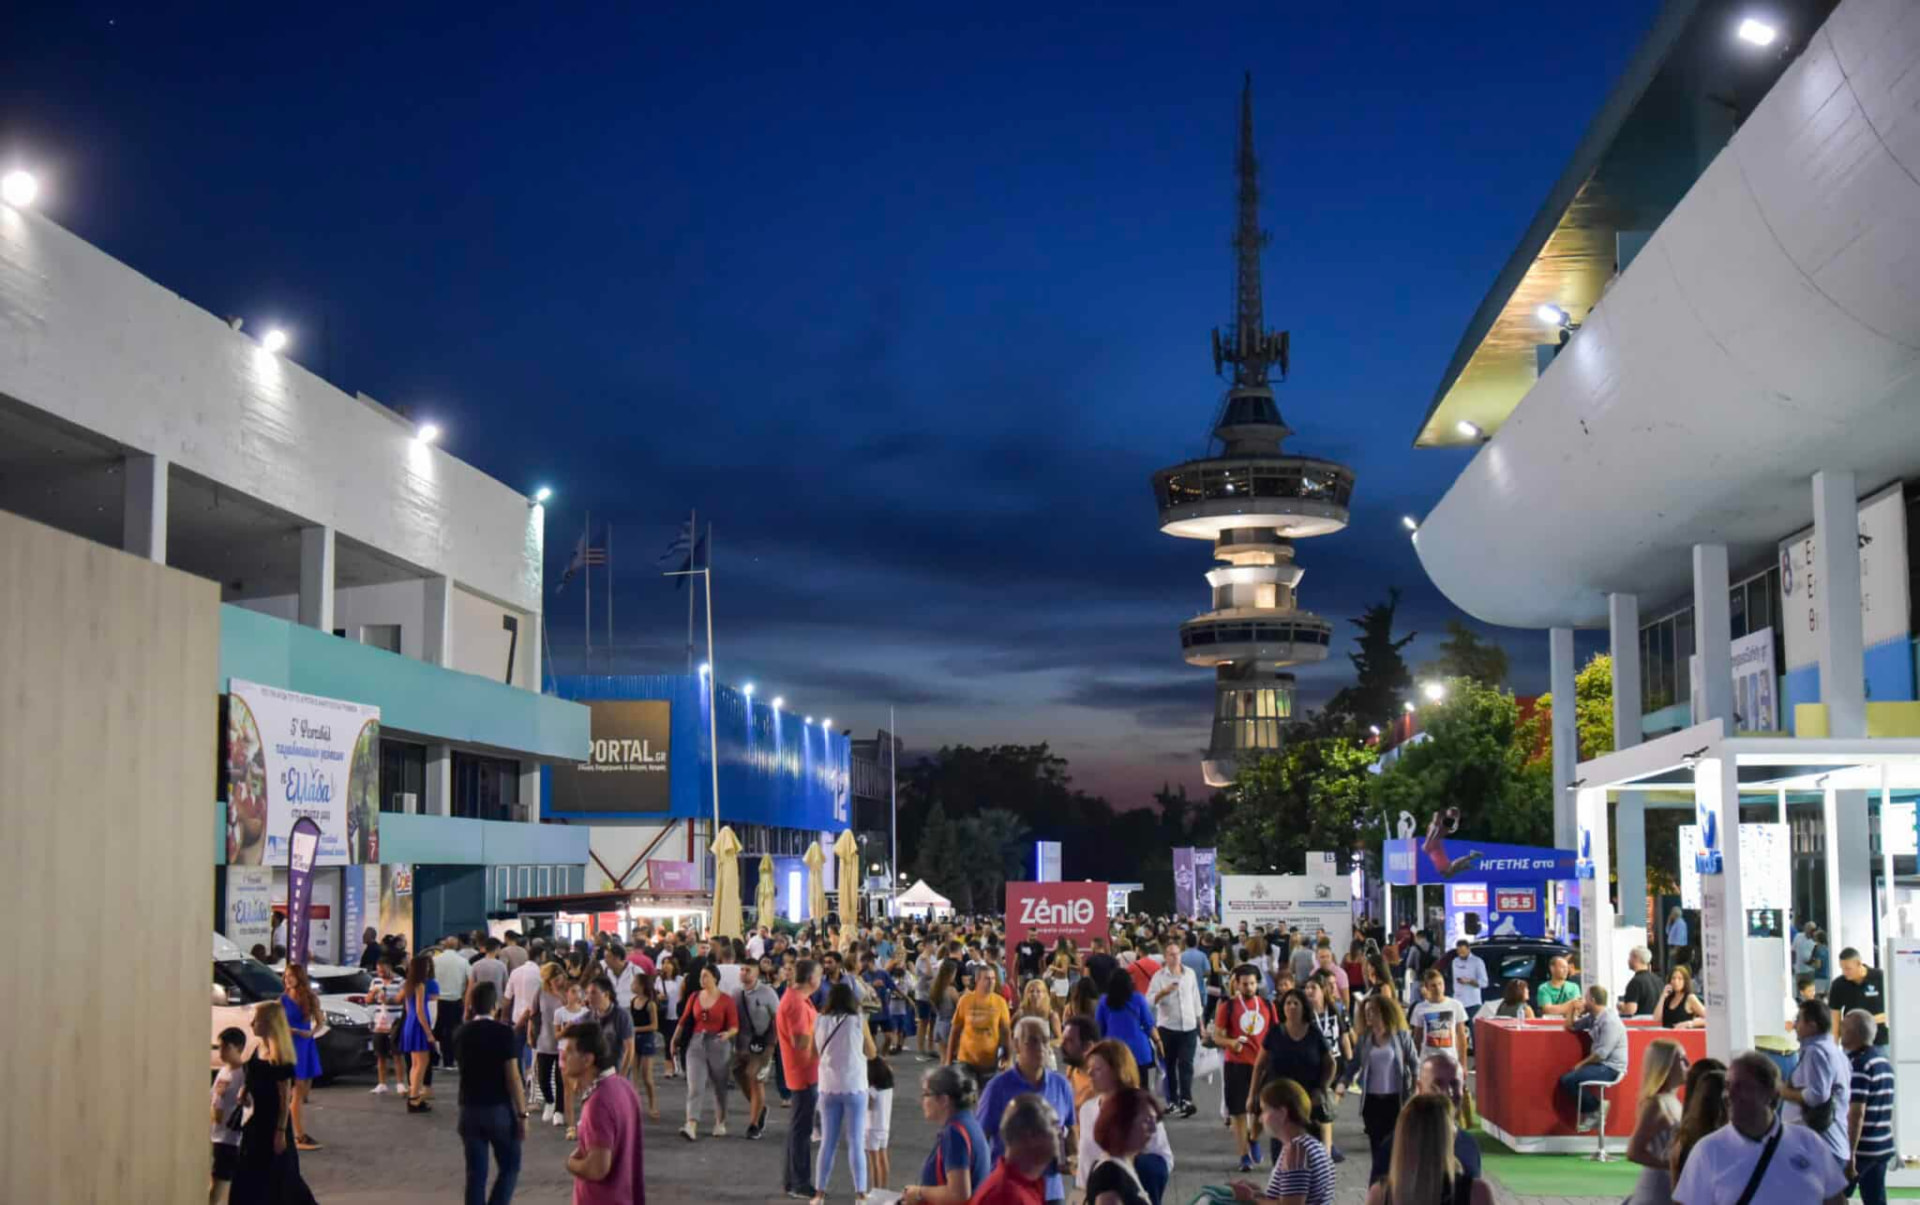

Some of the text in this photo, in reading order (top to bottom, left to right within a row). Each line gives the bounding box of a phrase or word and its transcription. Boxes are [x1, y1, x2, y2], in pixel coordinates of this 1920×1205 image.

[1480, 858, 1530, 871] ΗΓΕΤΗΣ
[1533, 860, 1555, 869] στα
[1501, 896, 1531, 909] 95.5
